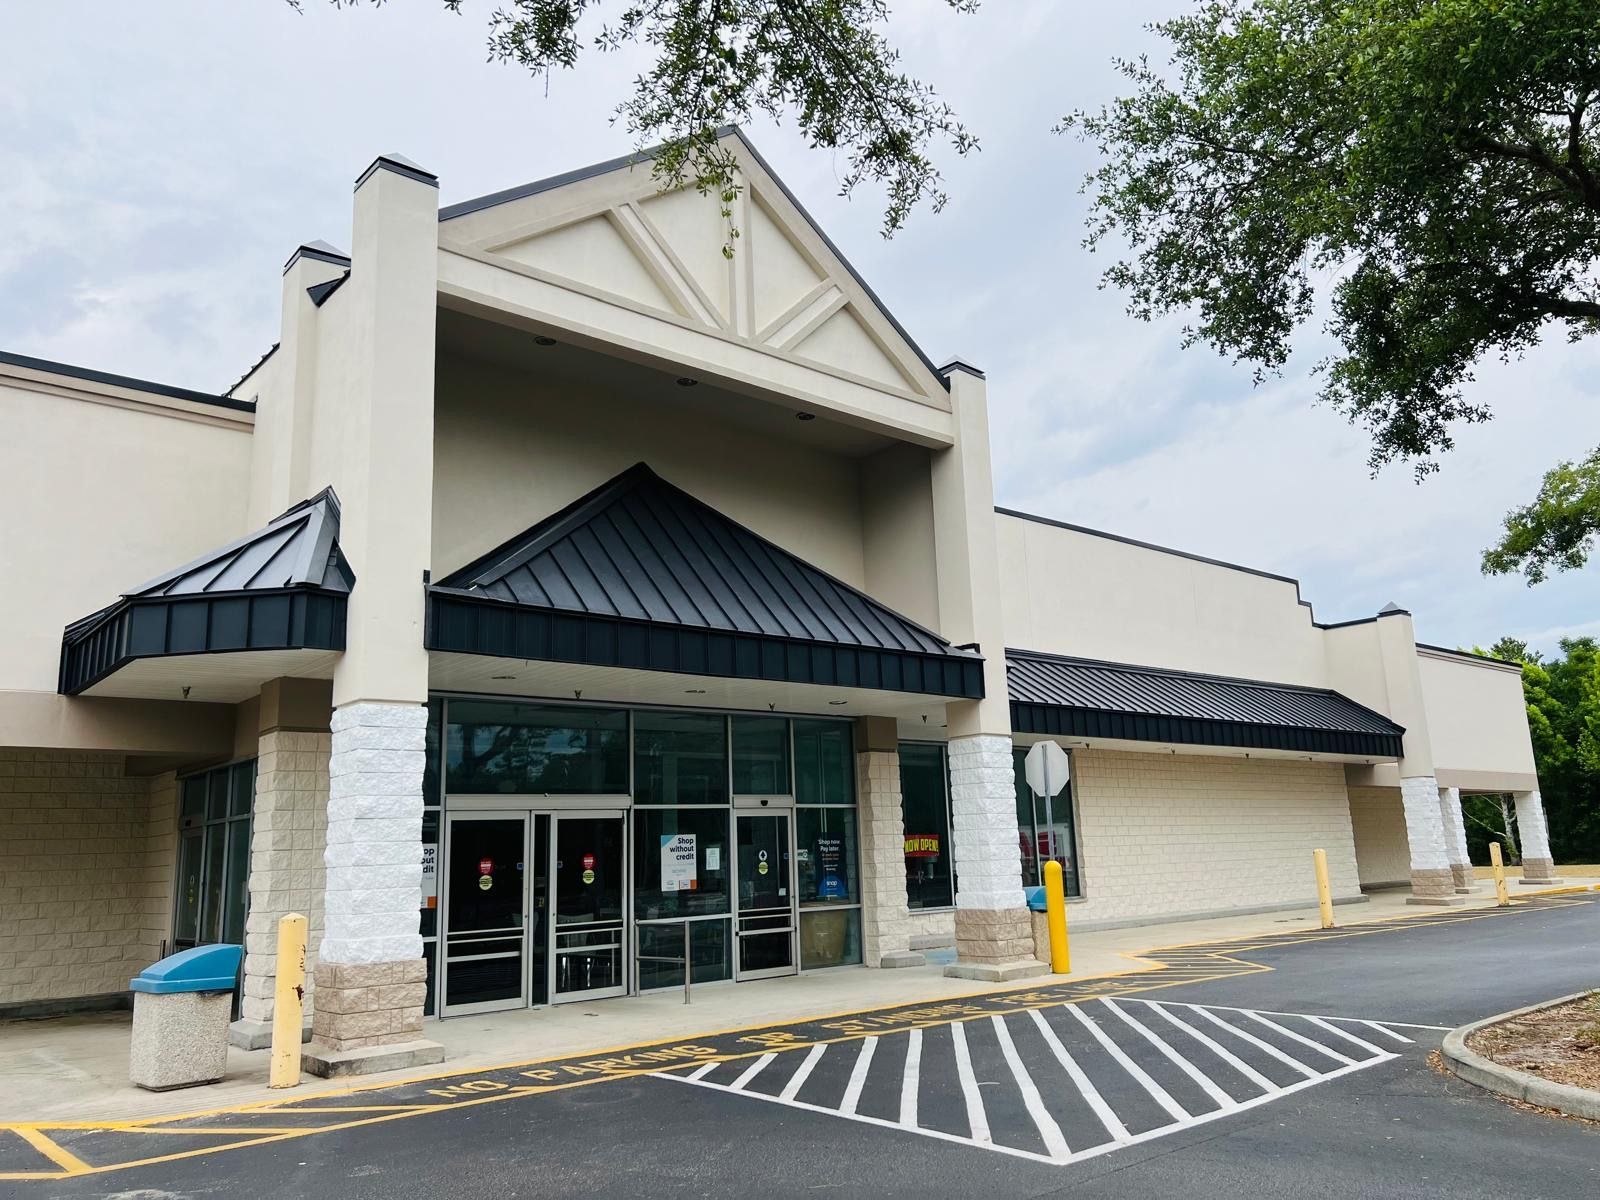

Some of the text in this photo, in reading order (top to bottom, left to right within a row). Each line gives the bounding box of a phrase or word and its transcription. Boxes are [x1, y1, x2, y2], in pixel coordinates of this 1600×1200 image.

[677, 837, 694, 846] Shop
[904, 838, 939, 852] NOW OPEN!
[669, 845, 694, 853] without
[676, 853, 694, 861] credit
[424, 1080, 509, 1098] NO
[519, 1044, 718, 1081] PARKING
[736, 1031, 808, 1045] OR
[821, 1004, 984, 1031] STANDING
